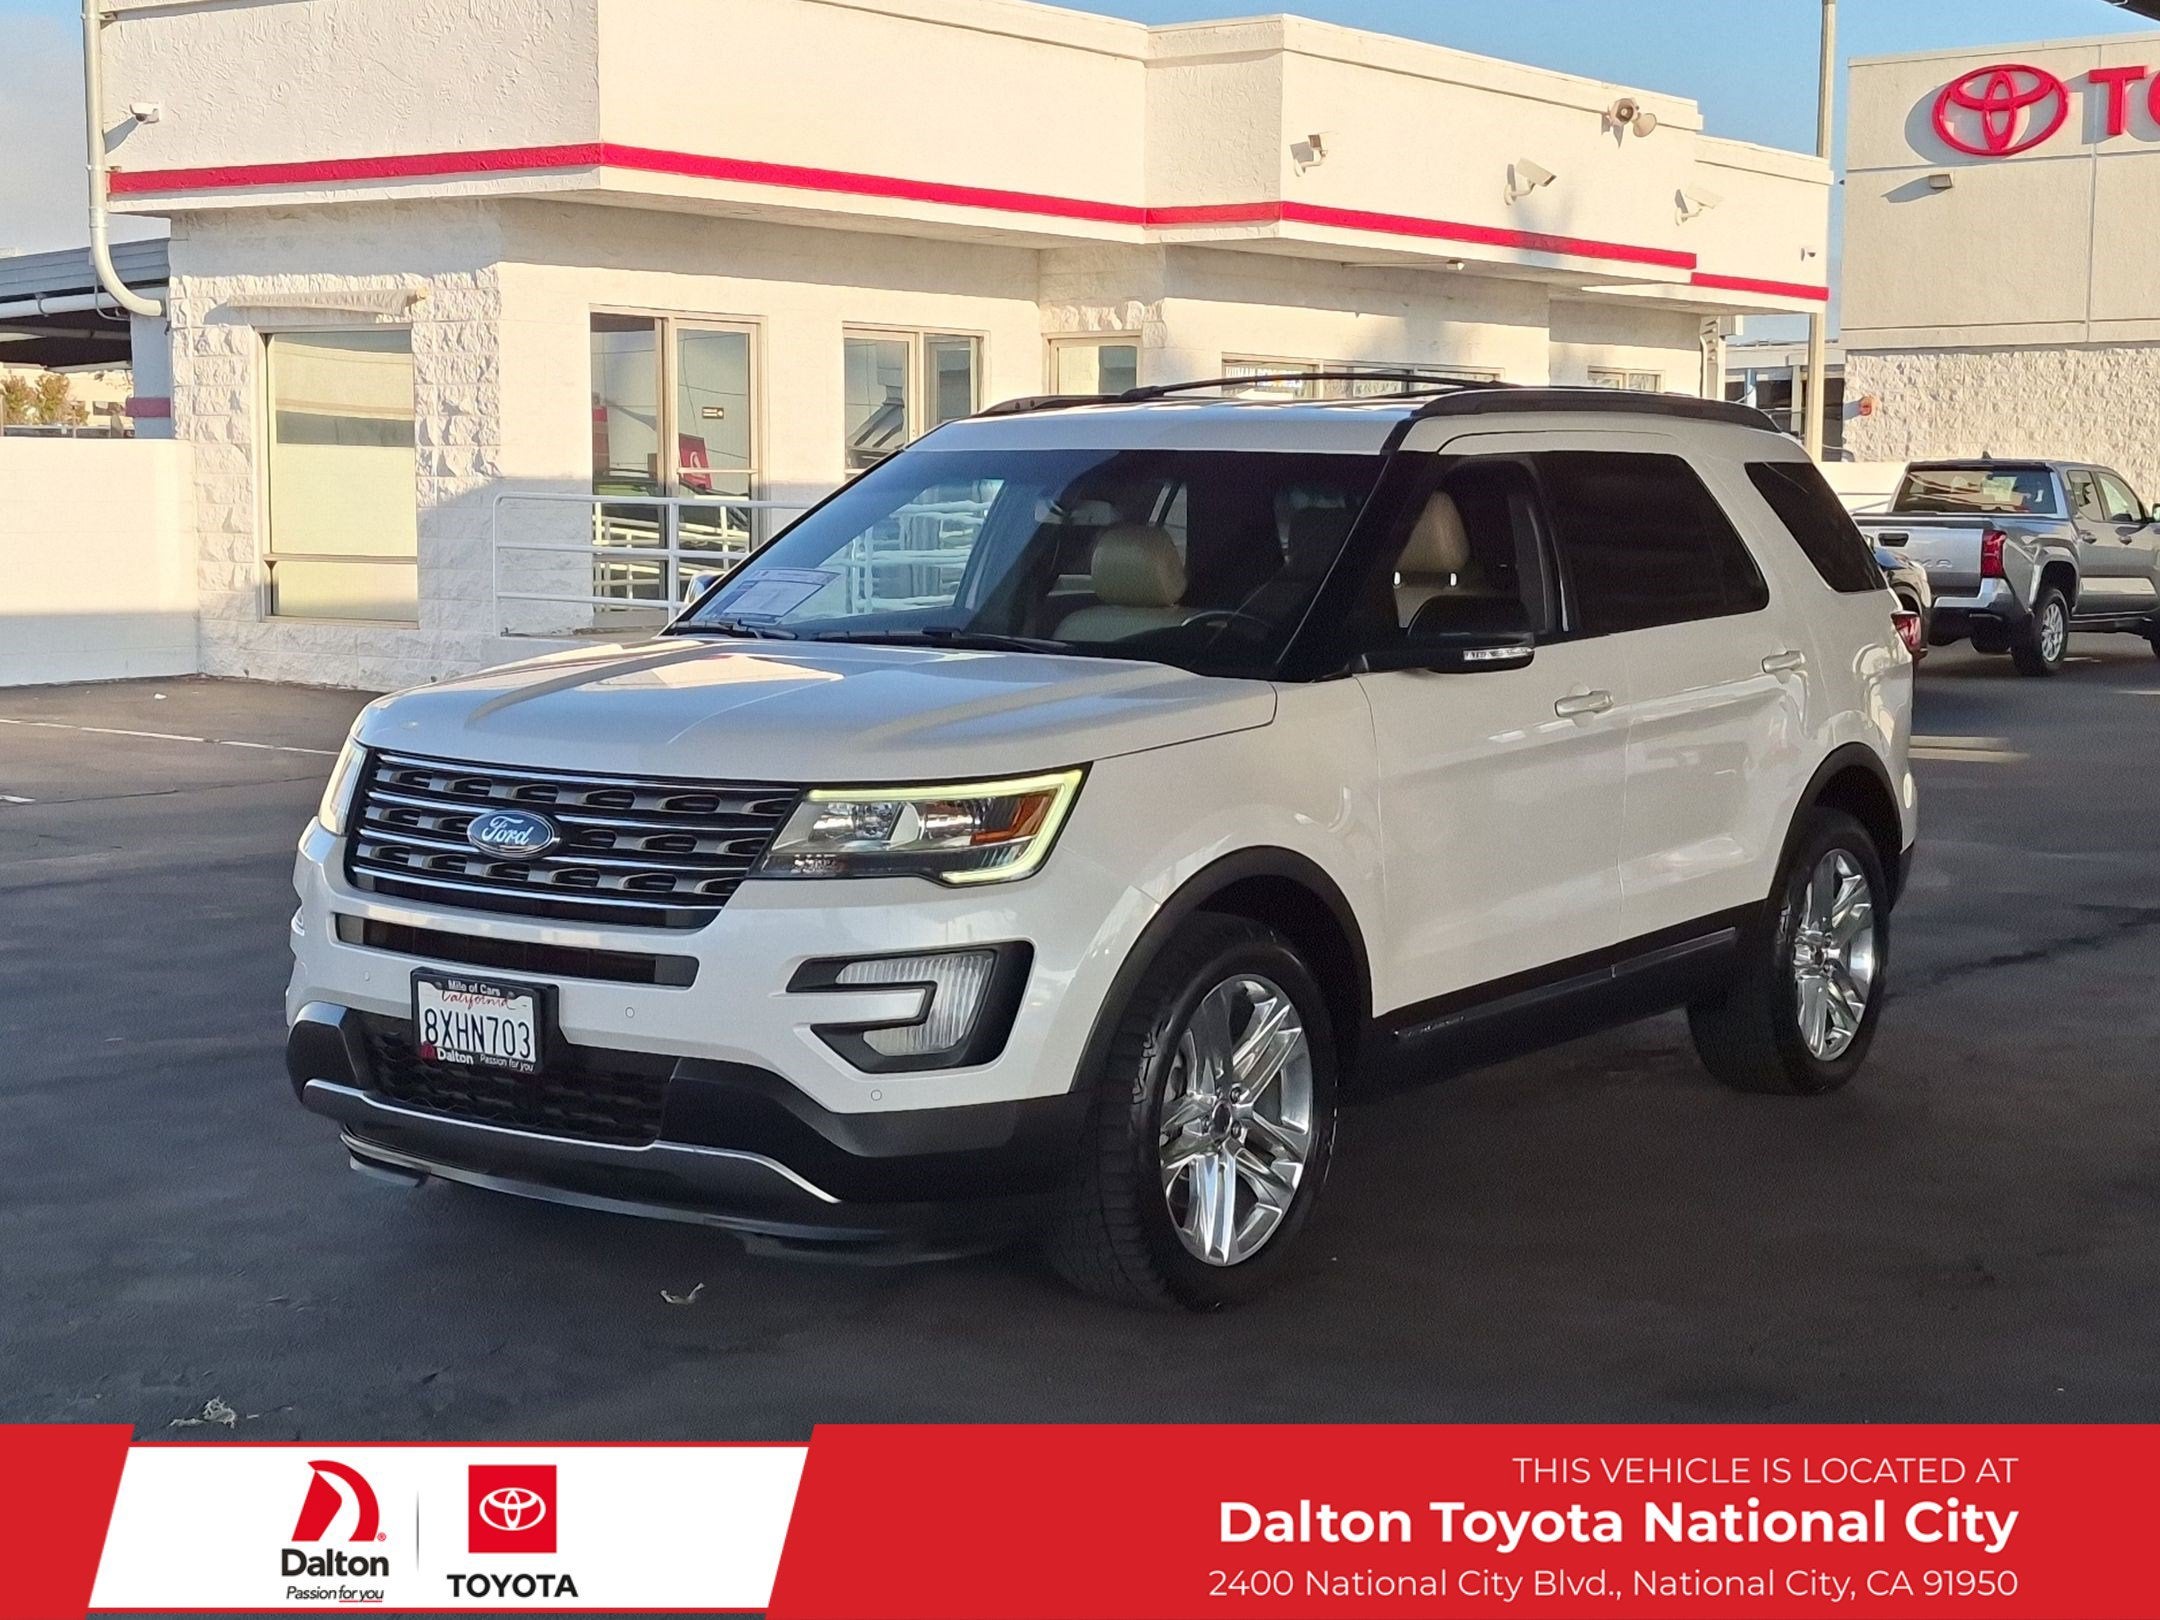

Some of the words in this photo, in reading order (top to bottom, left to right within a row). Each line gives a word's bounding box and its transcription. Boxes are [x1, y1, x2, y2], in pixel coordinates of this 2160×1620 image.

[2087, 65, 2160, 136] T
[481, 815, 534, 846] Ford
[447, 979, 468, 992] Mile
[468, 982, 479, 993] of
[480, 984, 501, 996] Cars
[424, 1007, 531, 1060] 8XHN703
[437, 1048, 474, 1066] Dalton
[480, 1053, 508, 1068] Passion
[509, 1058, 519, 1070] for
[520, 1061, 535, 1073] you
